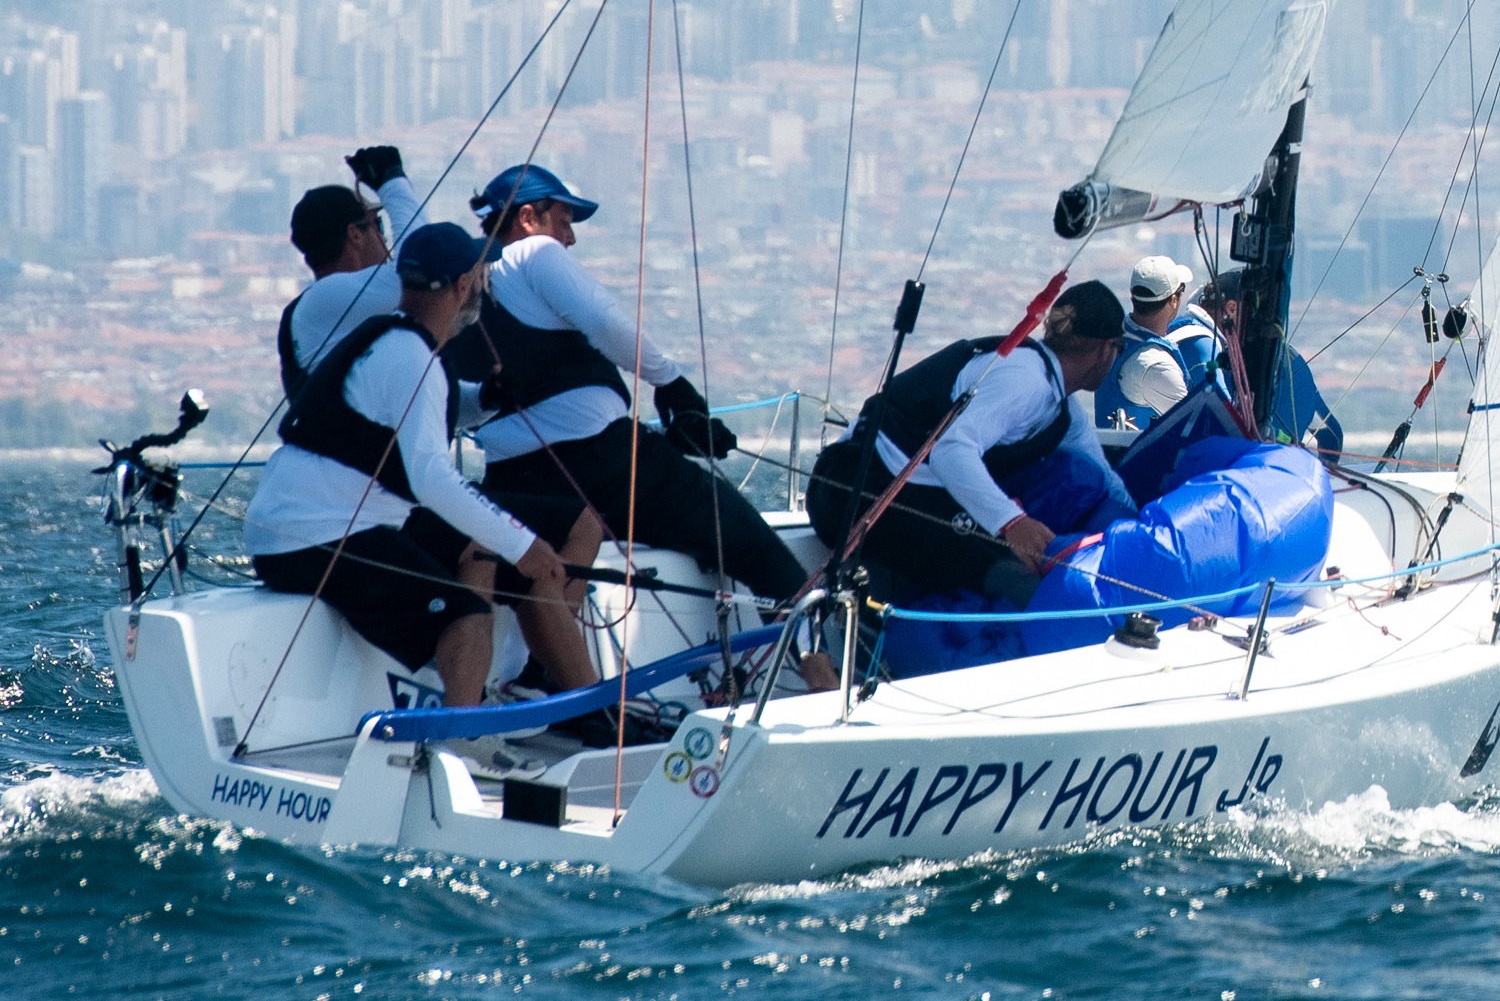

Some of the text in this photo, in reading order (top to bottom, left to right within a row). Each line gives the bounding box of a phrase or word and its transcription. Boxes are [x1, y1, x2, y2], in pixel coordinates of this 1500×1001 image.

[211, 773, 331, 824] HAPPY HOUR
[815, 759, 1053, 839] HAPPY
[1037, 744, 1218, 831] HOUR
